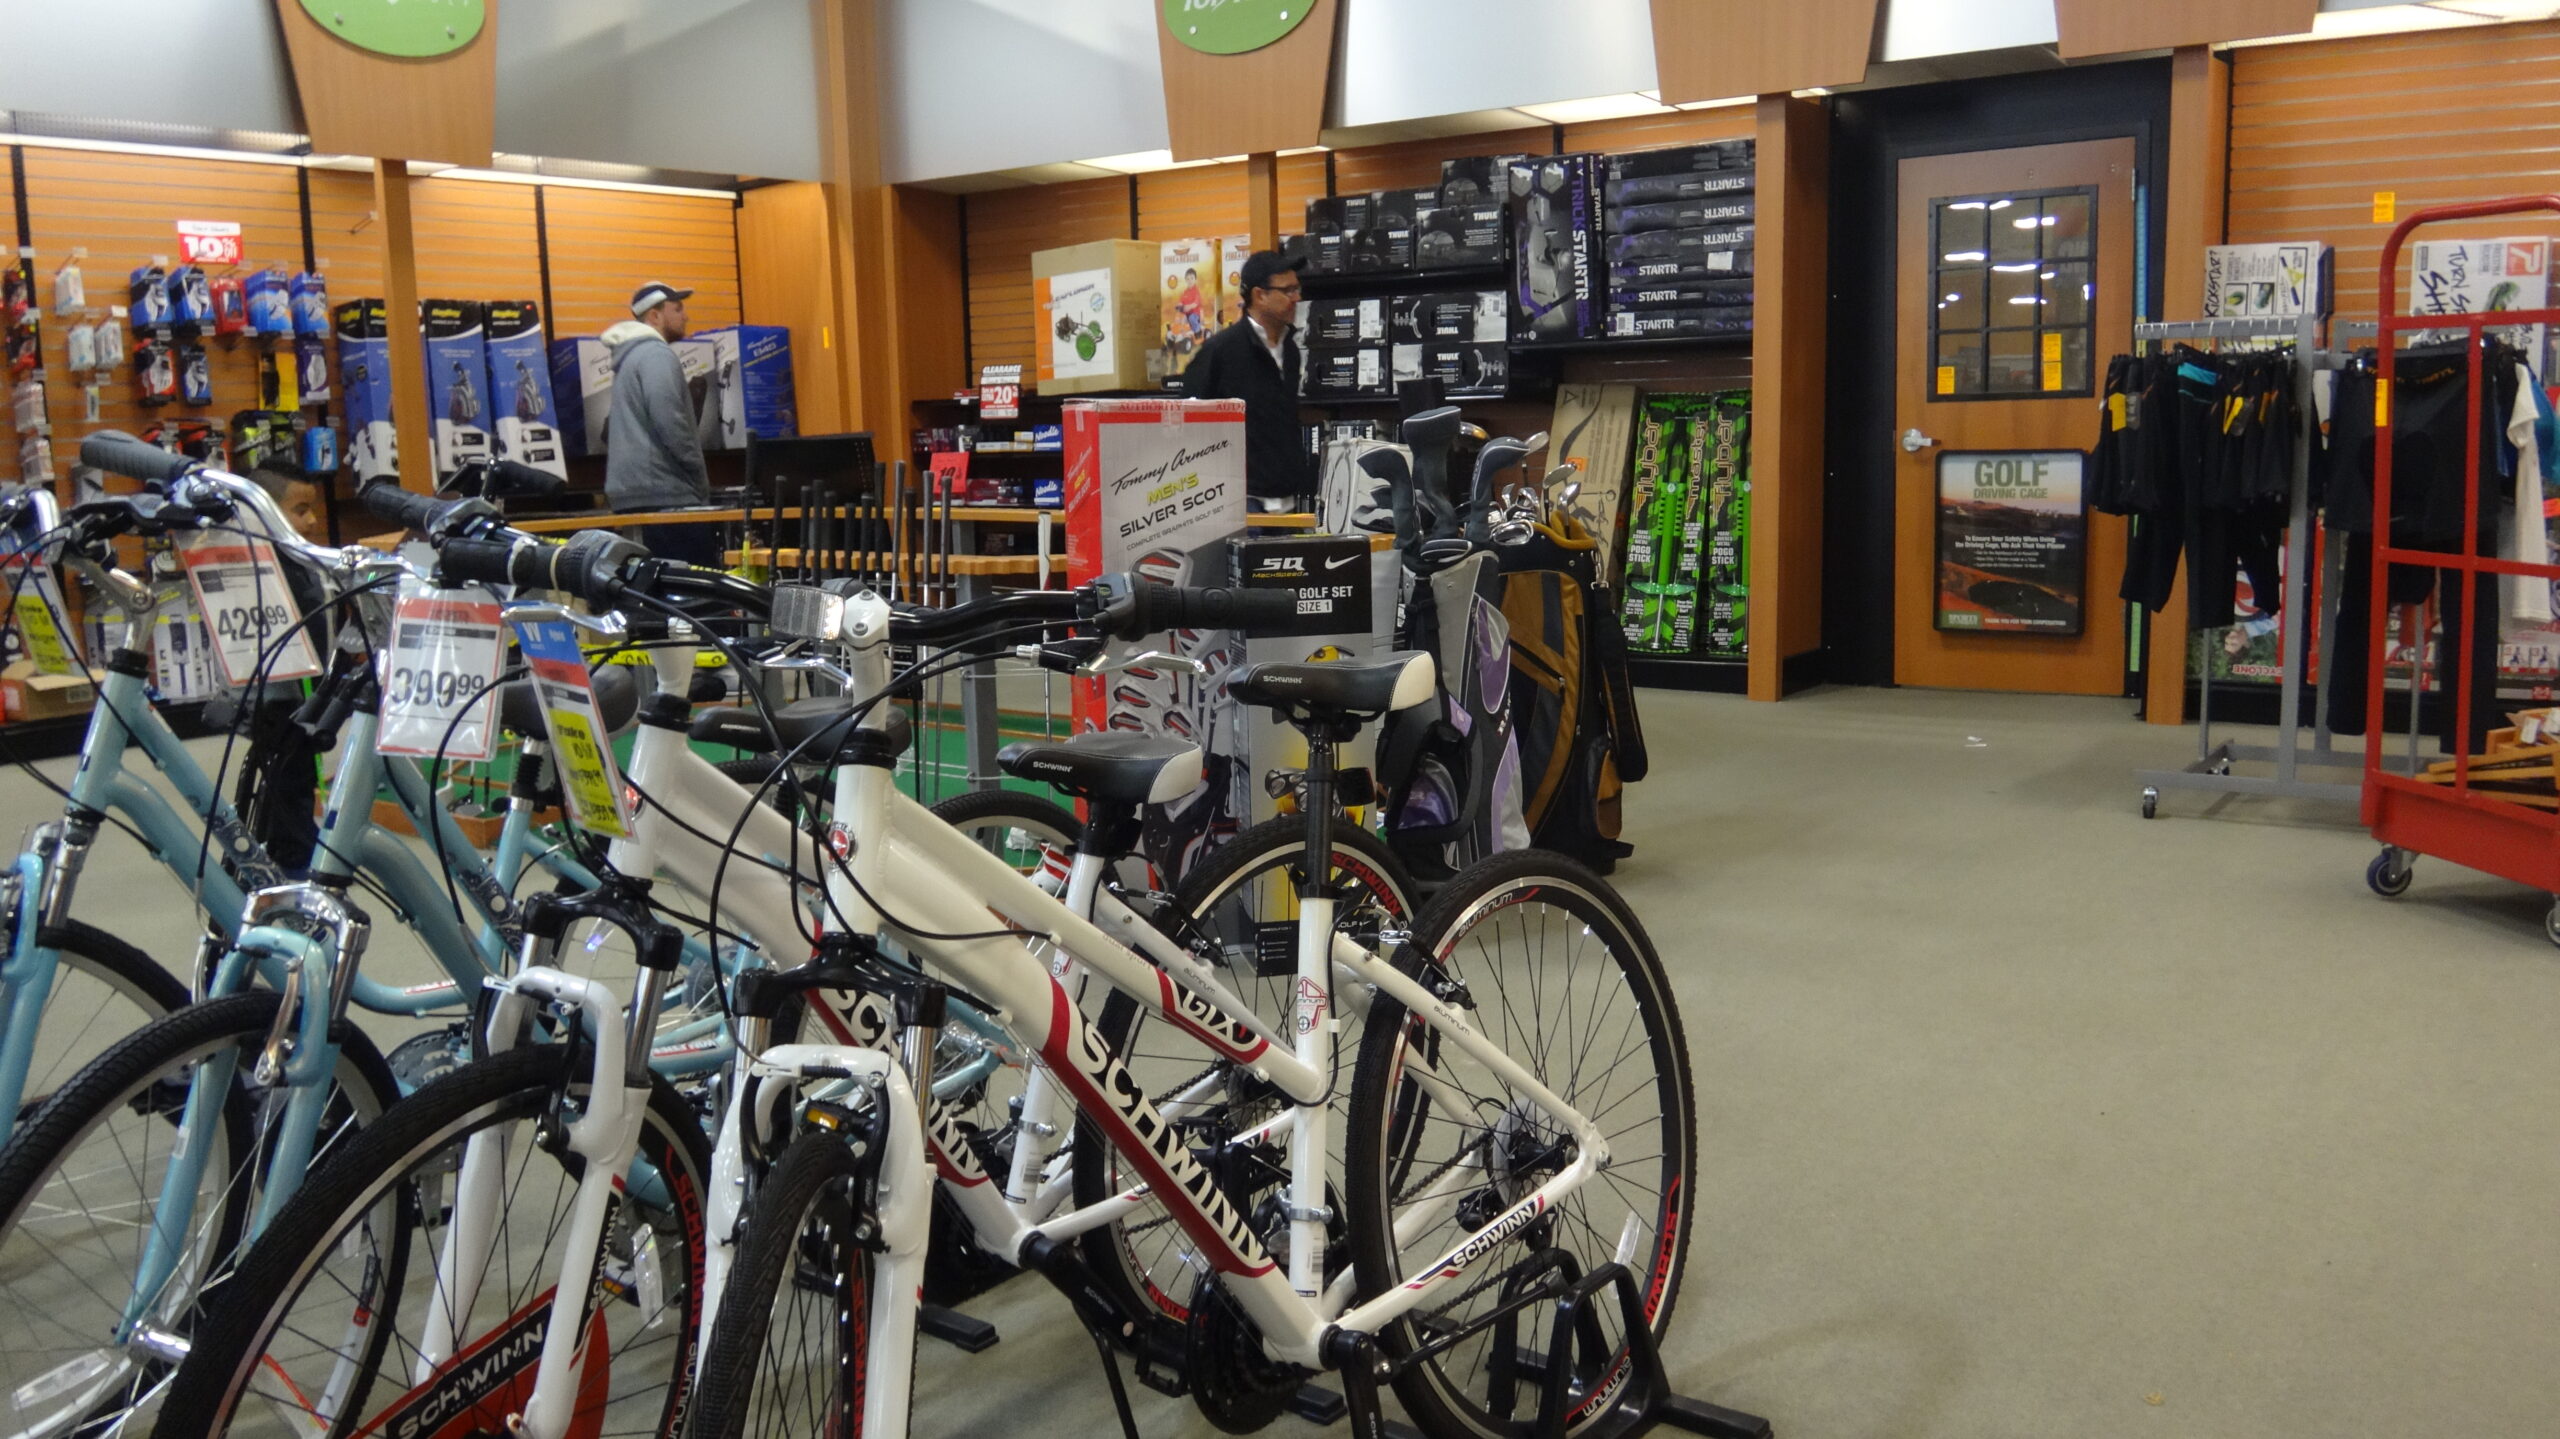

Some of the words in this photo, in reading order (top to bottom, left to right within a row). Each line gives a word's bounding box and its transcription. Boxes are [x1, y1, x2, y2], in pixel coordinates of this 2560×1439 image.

[1704, 177, 1746, 192] STARTR
[1346, 199, 1366, 207] THULE
[1473, 211, 1498, 221] THULE
[1704, 205, 1746, 219] STARTR
[1320, 235, 1340, 244] THULE
[1388, 230, 1409, 239] THULE
[183, 236, 224, 259] 10
[1334, 308, 1355, 317] THULE
[1436, 326, 1459, 335] THULE
[1635, 319, 1675, 330] STARTR
[1333, 357, 1354, 365] THULE
[1437, 352, 1460, 361] THULE
[982, 364, 1022, 374] CLEARANCE
[993, 385, 1012, 404] 20
[1035, 425, 1060, 441] Noodle
[1110, 463, 1168, 496] Tommy
[1171, 439, 1229, 472] Armour
[1974, 459, 2049, 487] GOLF
[1035, 481, 1058, 496] Noodle
[1147, 472, 1200, 507] MEN'S
[1973, 487, 2016, 499] DRIVING
[2020, 487, 2048, 499] CAGE
[1119, 504, 1178, 538] SILVER
[1182, 483, 1225, 513] SCOT
[1126, 532, 1162, 552] COMPLETE
[1162, 518, 1195, 538] GRAPHITE
[1195, 510, 1212, 523] GOLF
[1212, 504, 1225, 516] SET
[1631, 545, 1651, 555] POGO
[1713, 547, 1734, 556] POGO
[1629, 554, 1651, 563] STICK
[1711, 556, 1735, 565] STICK
[1299, 587, 1329, 600] GOLF
[1331, 585, 1353, 598] SET
[1298, 601, 1321, 613] SIZE
[1325, 600, 1331, 612] 1
[218, 606, 272, 640] 429
[1263, 675, 1302, 684] SCHWINN
[391, 667, 457, 708] 399
[1033, 761, 1073, 772] SCHWINN
[1331, 852, 1403, 916] SCHWINN
[1458, 892, 1513, 937] aluminum
[1183, 967, 1216, 995] aluminum
[1433, 1004, 1470, 1036] aluminum
[1083, 1021, 1270, 1264] SCHWINN
[1452, 1205, 1534, 1269] SCHWINN
[398, 1322, 543, 1439] SCHWINN
